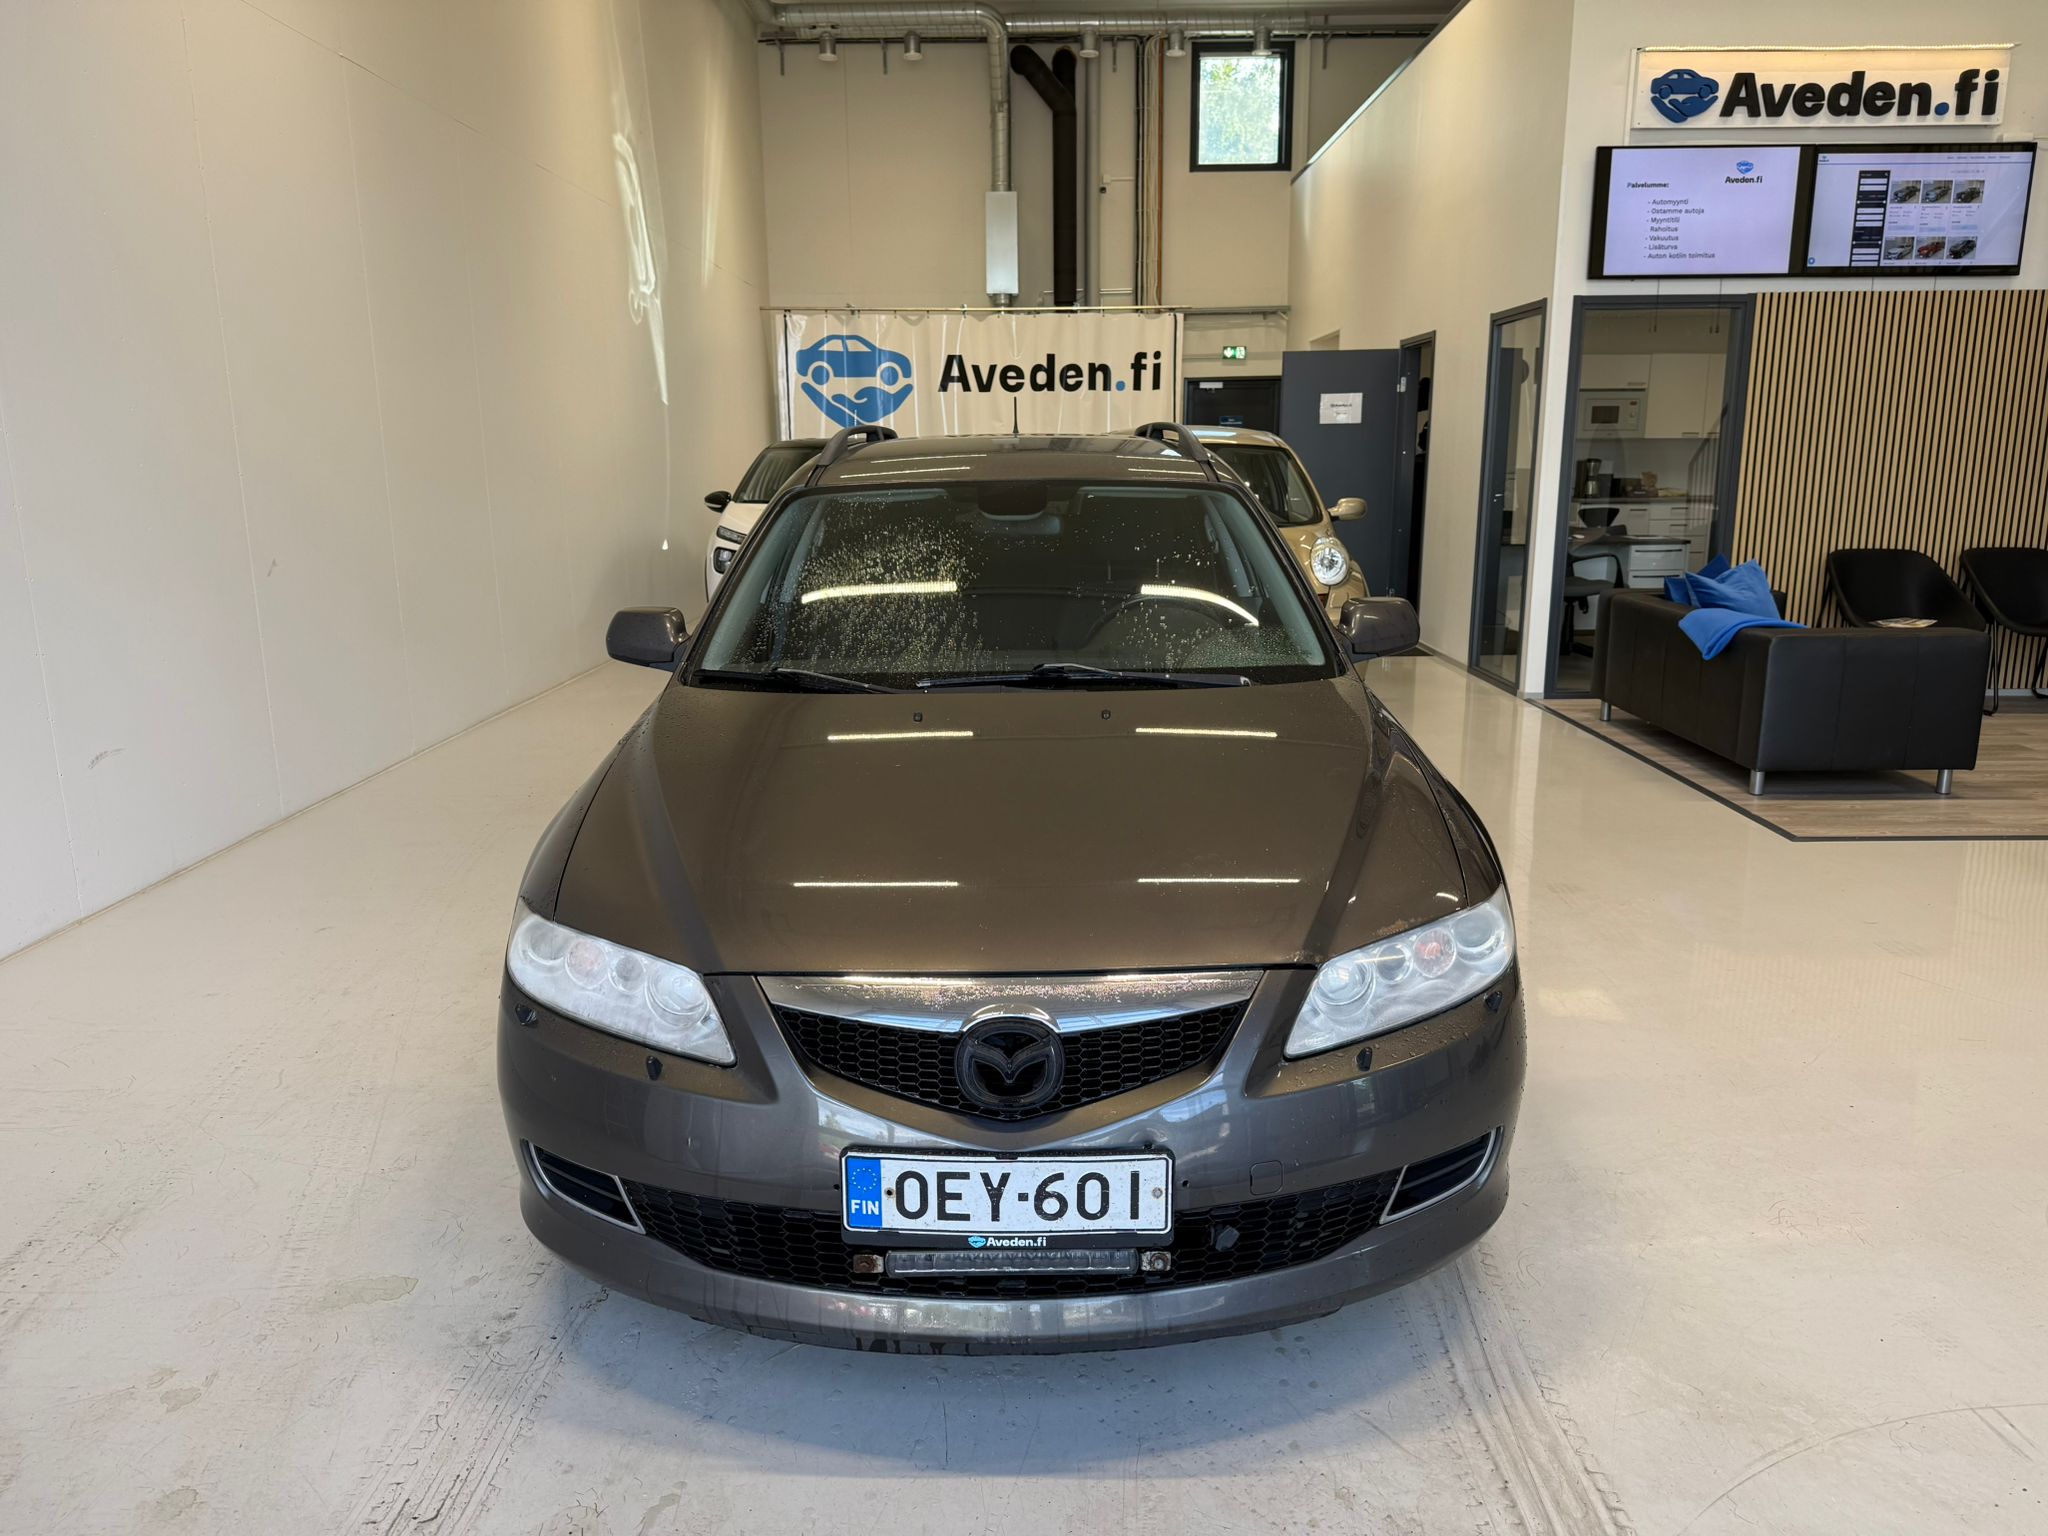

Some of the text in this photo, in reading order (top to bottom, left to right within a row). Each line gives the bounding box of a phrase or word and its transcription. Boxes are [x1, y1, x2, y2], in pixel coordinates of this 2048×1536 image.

[1719, 68, 2000, 118] Aveden.fi
[1725, 176, 1763, 184] Aveden.fi
[1651, 199, 1689, 207] Automyynti
[1684, 208, 1705, 216] autoja
[937, 351, 1162, 394] Aveden.fi
[895, 1170, 1141, 1223] OEY-601
[851, 1200, 880, 1216] FIN
[986, 1236, 1047, 1248] Aveden.fi
